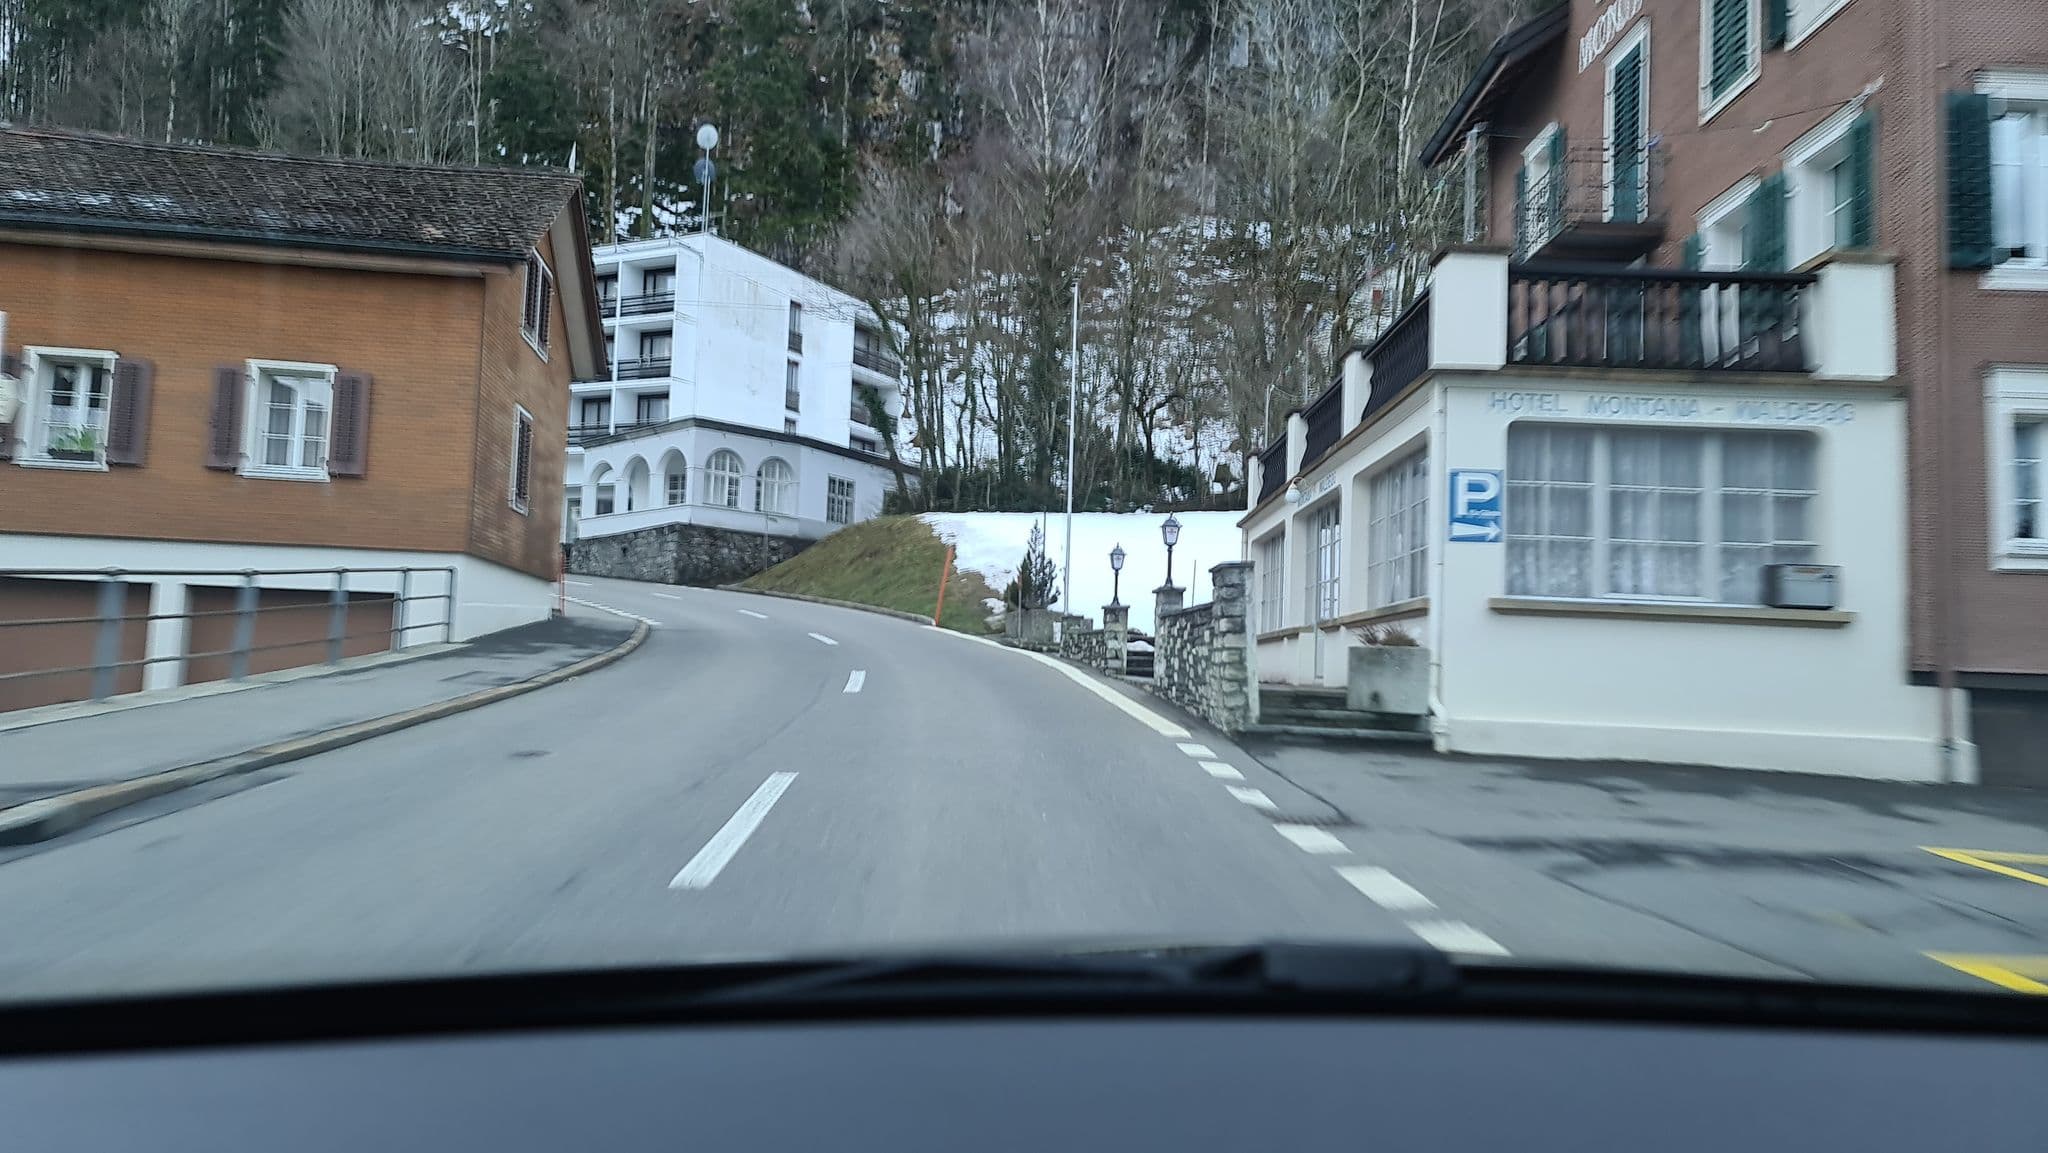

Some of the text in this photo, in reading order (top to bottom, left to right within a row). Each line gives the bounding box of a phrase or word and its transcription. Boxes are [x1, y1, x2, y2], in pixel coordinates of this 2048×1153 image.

[1490, 391, 1568, 412] HOTEL
[1584, 394, 1698, 418] MONTANA
[1457, 472, 1499, 515] P
